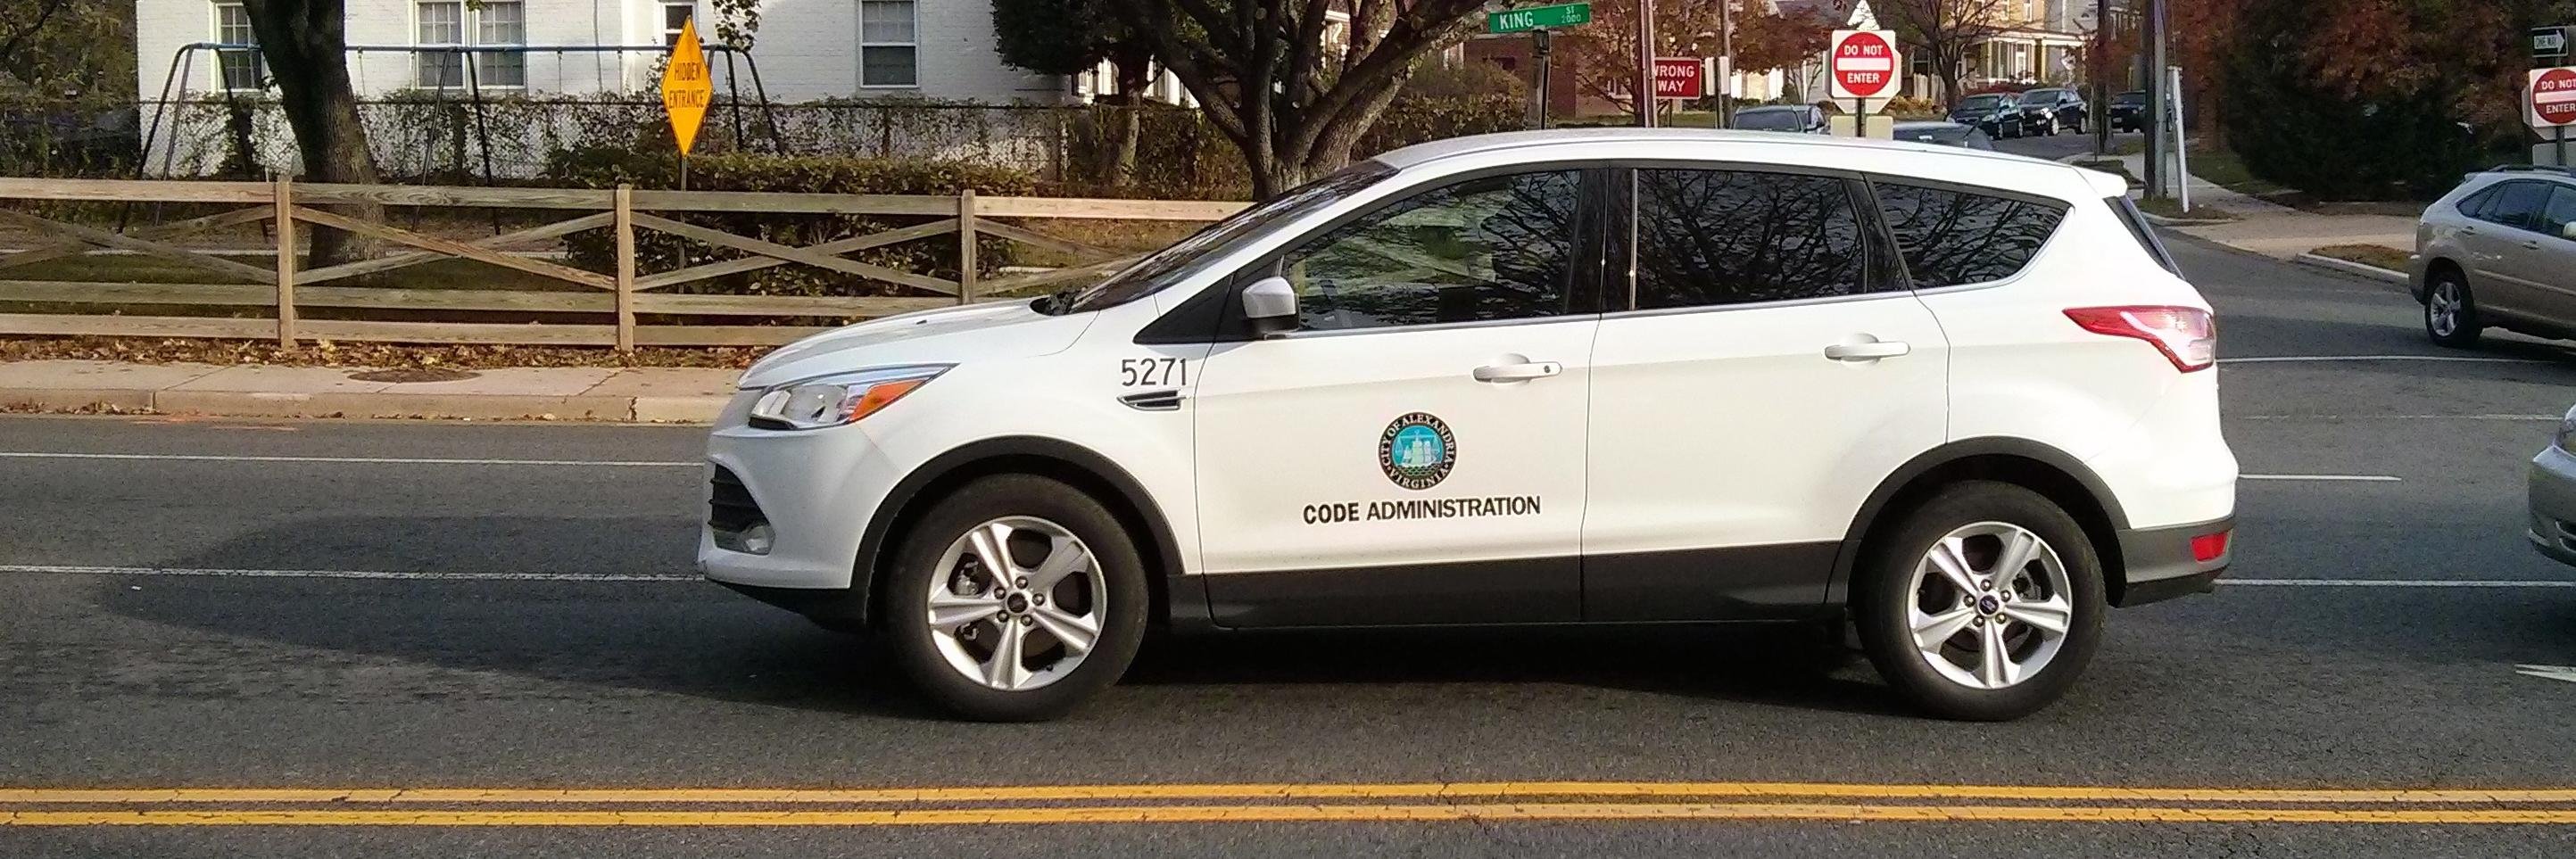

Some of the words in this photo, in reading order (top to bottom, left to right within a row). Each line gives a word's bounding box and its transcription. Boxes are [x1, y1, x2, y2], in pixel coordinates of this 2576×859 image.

[1566, 5, 1575, 14] ST
[1499, 12, 1534, 29] KING
[1561, 13, 1581, 24] 2000
[1843, 45, 1859, 55] DO
[1863, 45, 1884, 55] NOT
[674, 62, 700, 81] HIDDEN
[1847, 72, 1880, 84] ENTER
[1658, 80, 1686, 92] WAY
[2541, 80, 2555, 90] DO
[669, 90, 705, 109] ENTRANCE
[2546, 103, 2576, 114] ENTER
[1122, 358, 1186, 386] 5271
[1380, 435, 1391, 467] CITY
[1387, 422, 1401, 438] OF
[1402, 414, 1454, 463] ALEXANDRIA
[1389, 467, 1449, 489] VIRGINIA
[1303, 502, 1359, 524] CODE
[1366, 496, 1541, 521] ADMINISTRATION
